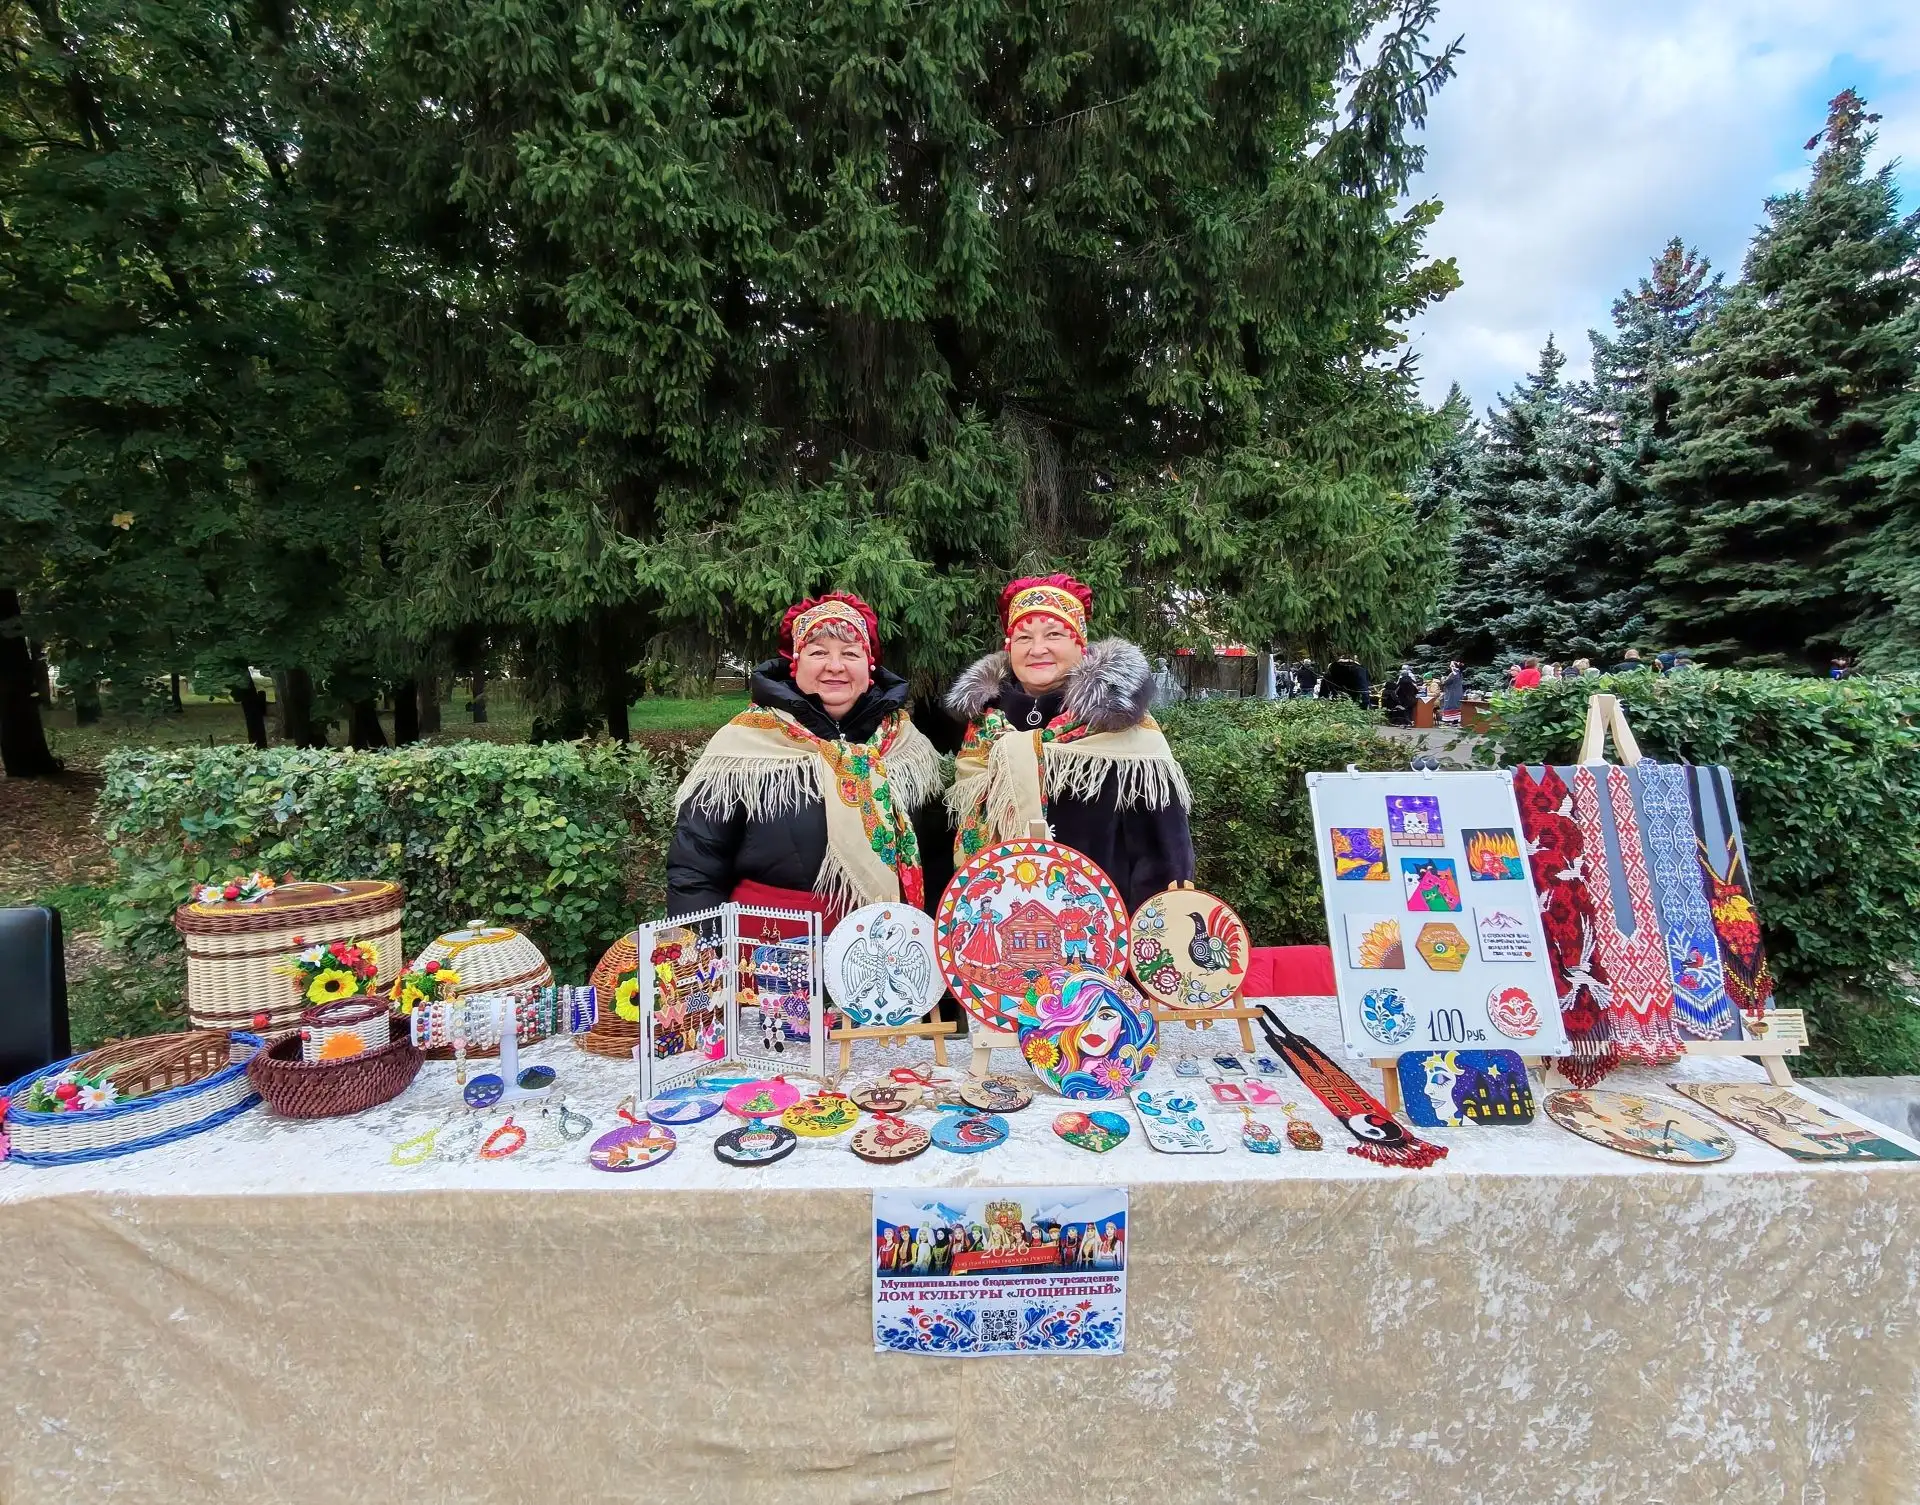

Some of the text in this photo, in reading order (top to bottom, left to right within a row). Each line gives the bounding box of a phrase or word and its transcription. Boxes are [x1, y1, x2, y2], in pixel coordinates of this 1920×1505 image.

[1428, 1009, 1465, 1043] 100
[980, 1242, 1030, 1259] 2026
[880, 1275, 1120, 1290] Муниципальное бюджетное учреждение
[877, 1283, 1122, 1302] ДОМ КУЛЬТУРЫ «ЛОЩИННЫЙ»
